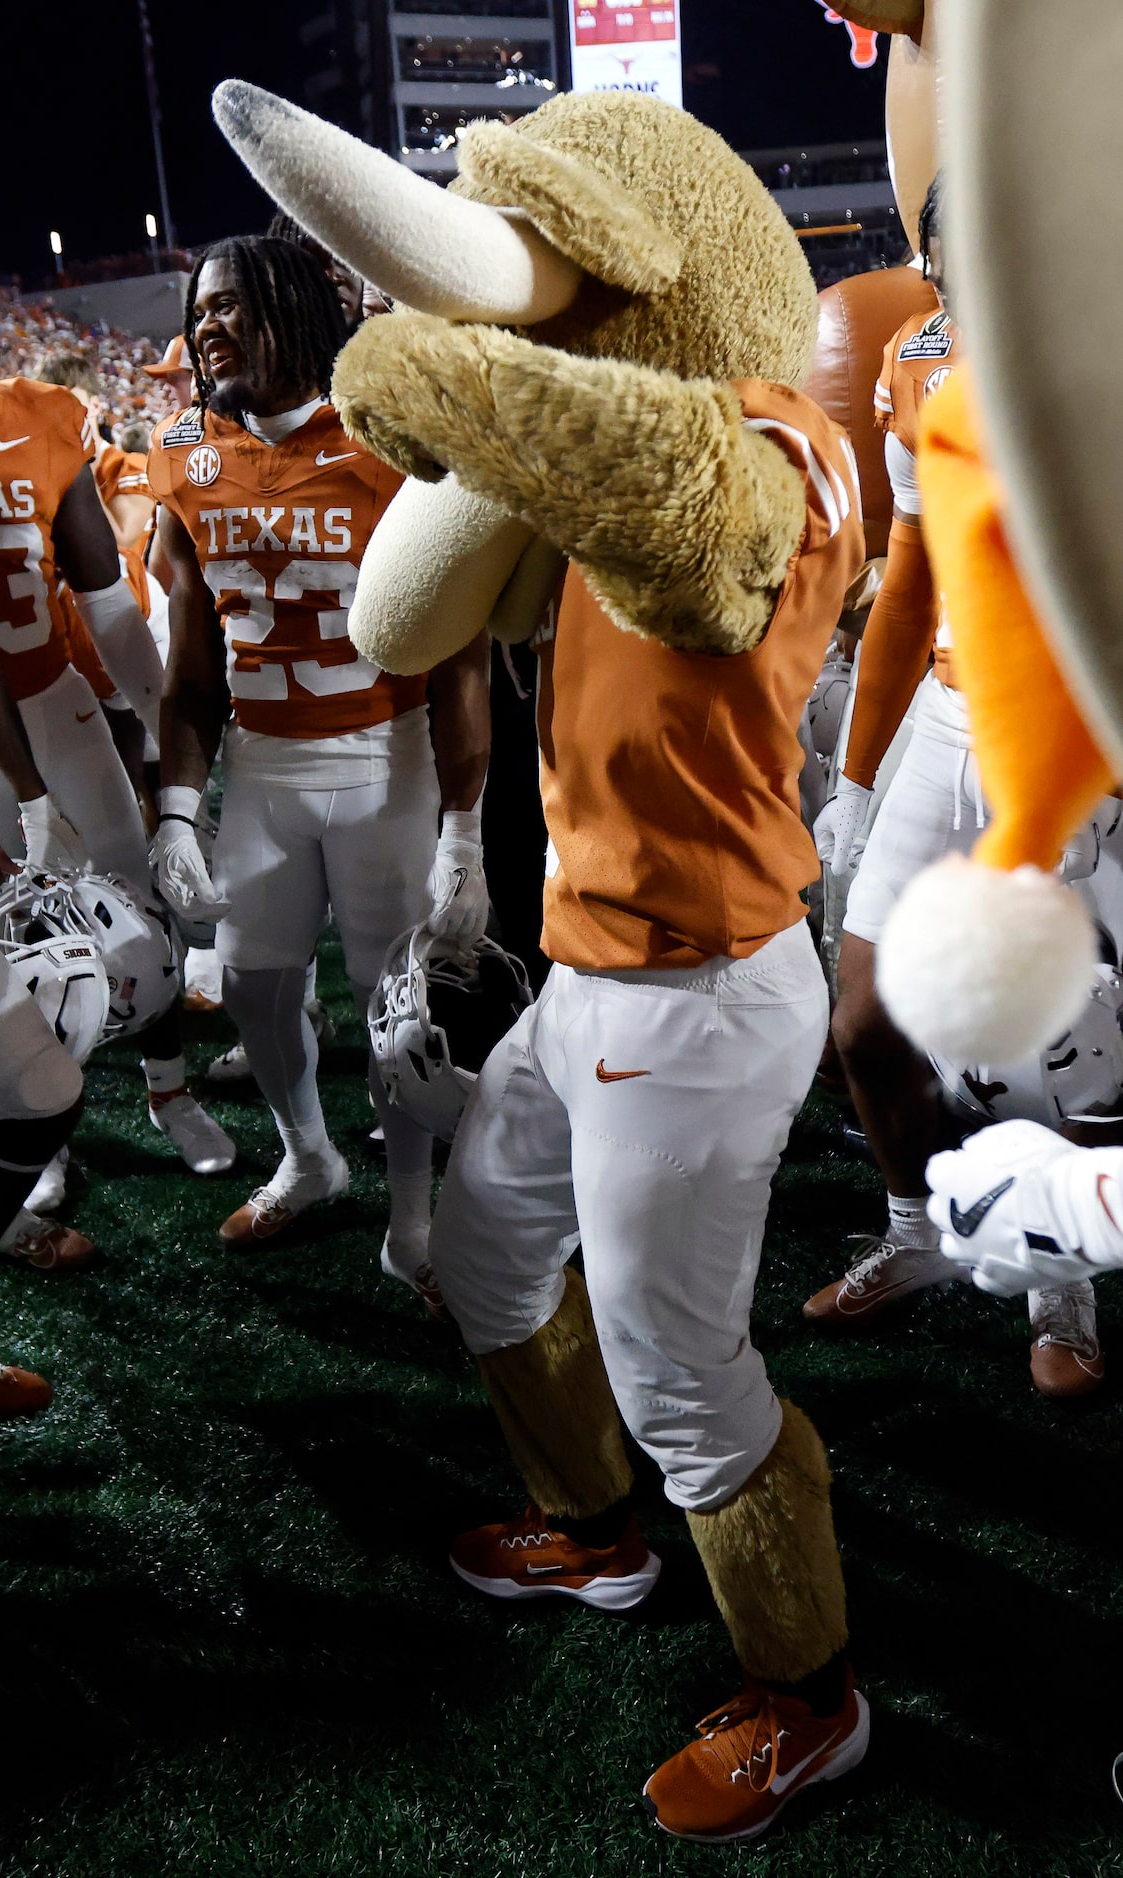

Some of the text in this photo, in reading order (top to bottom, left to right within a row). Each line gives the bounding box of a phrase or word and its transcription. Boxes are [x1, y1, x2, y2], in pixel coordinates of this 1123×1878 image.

[189, 448, 217, 483] SEC
[199, 506, 352, 554] TEXAS
[203, 559, 382, 700] 23
